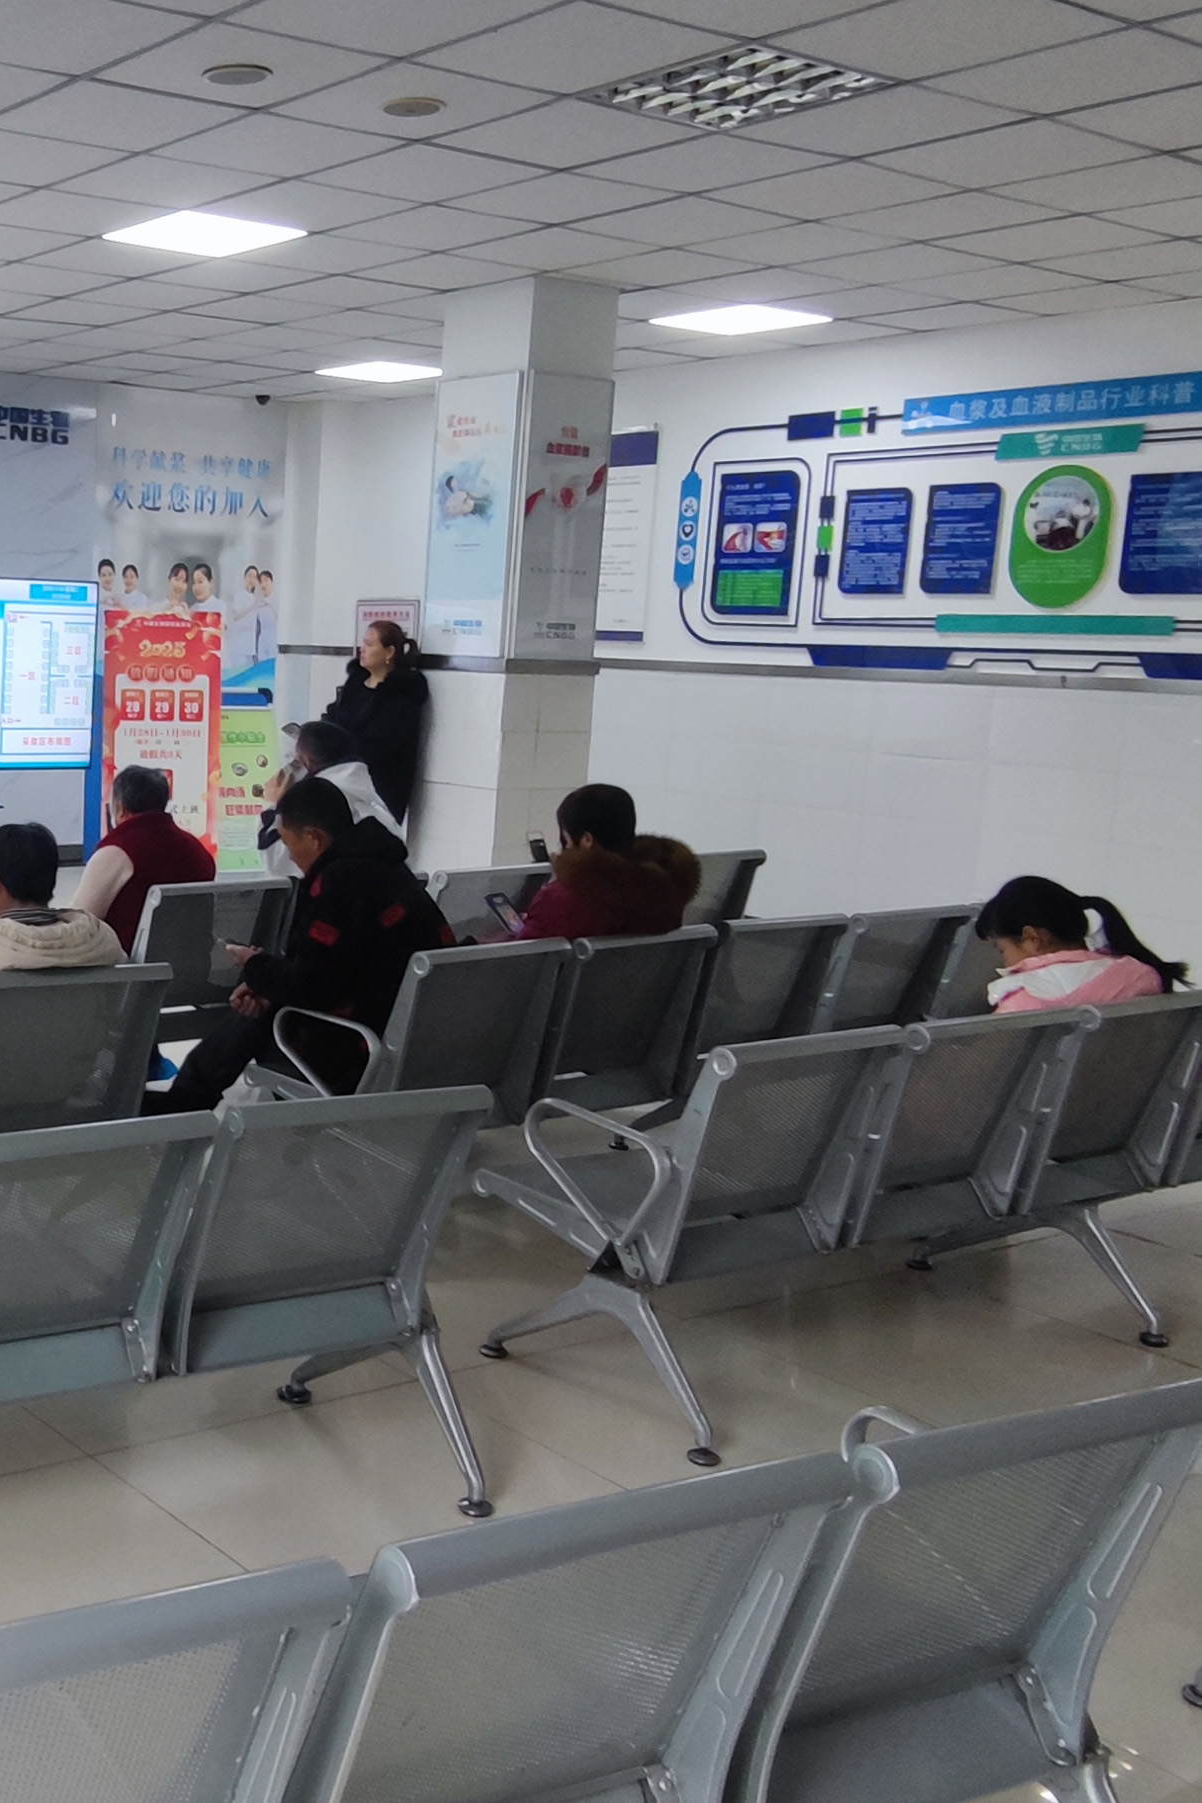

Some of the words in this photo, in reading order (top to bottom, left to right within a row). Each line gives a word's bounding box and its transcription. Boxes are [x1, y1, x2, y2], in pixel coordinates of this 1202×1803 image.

[949, 381, 1196, 420] 血浆及血液制品行业科普
[112, 479, 269, 518] 欢迎您的加入
[139, 639, 186, 658] 2025
